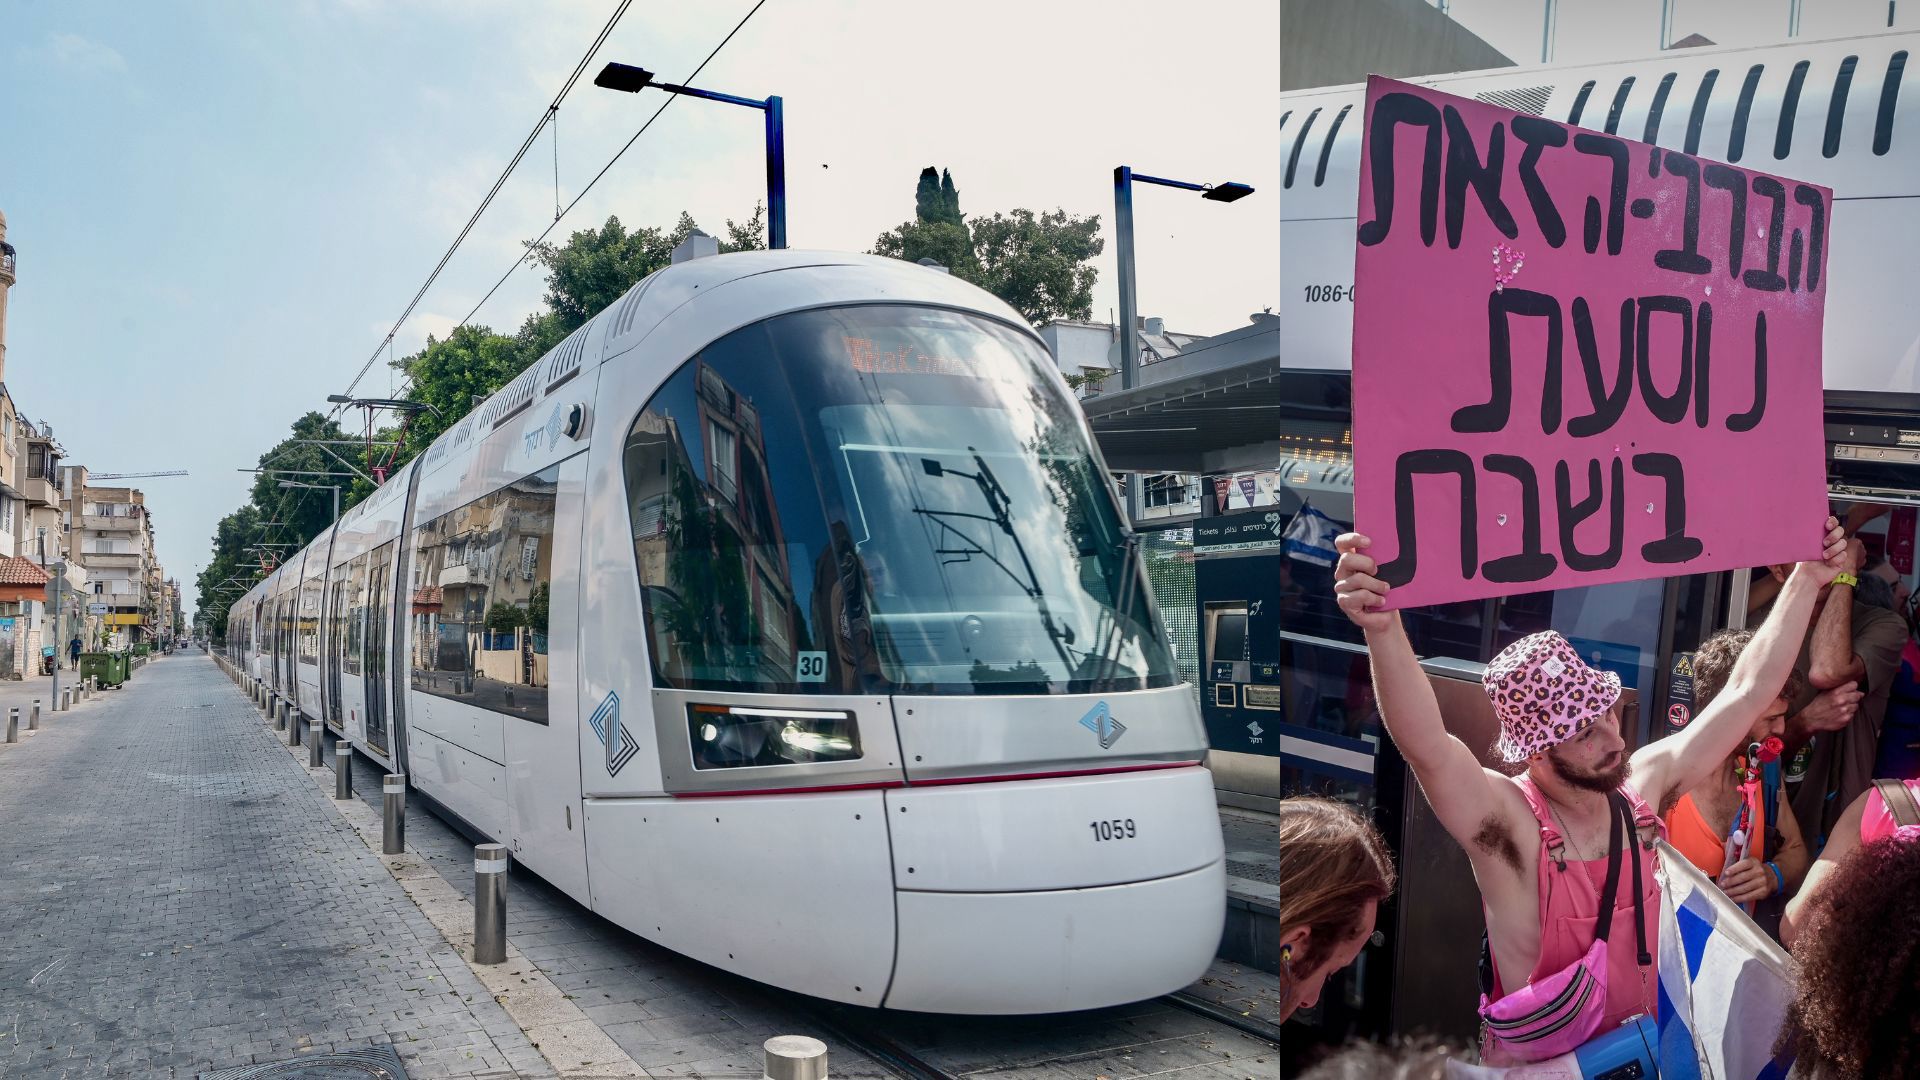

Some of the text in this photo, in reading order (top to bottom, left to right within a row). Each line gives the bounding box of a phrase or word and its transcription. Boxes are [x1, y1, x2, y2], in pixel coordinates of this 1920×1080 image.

[1450, 287, 1768, 438] נוסעת
[1376, 448, 1704, 590] בשבת
[1198, 528, 1219, 536] Tickets
[799, 656, 824, 676] 30
[1089, 818, 1137, 842] 1059
